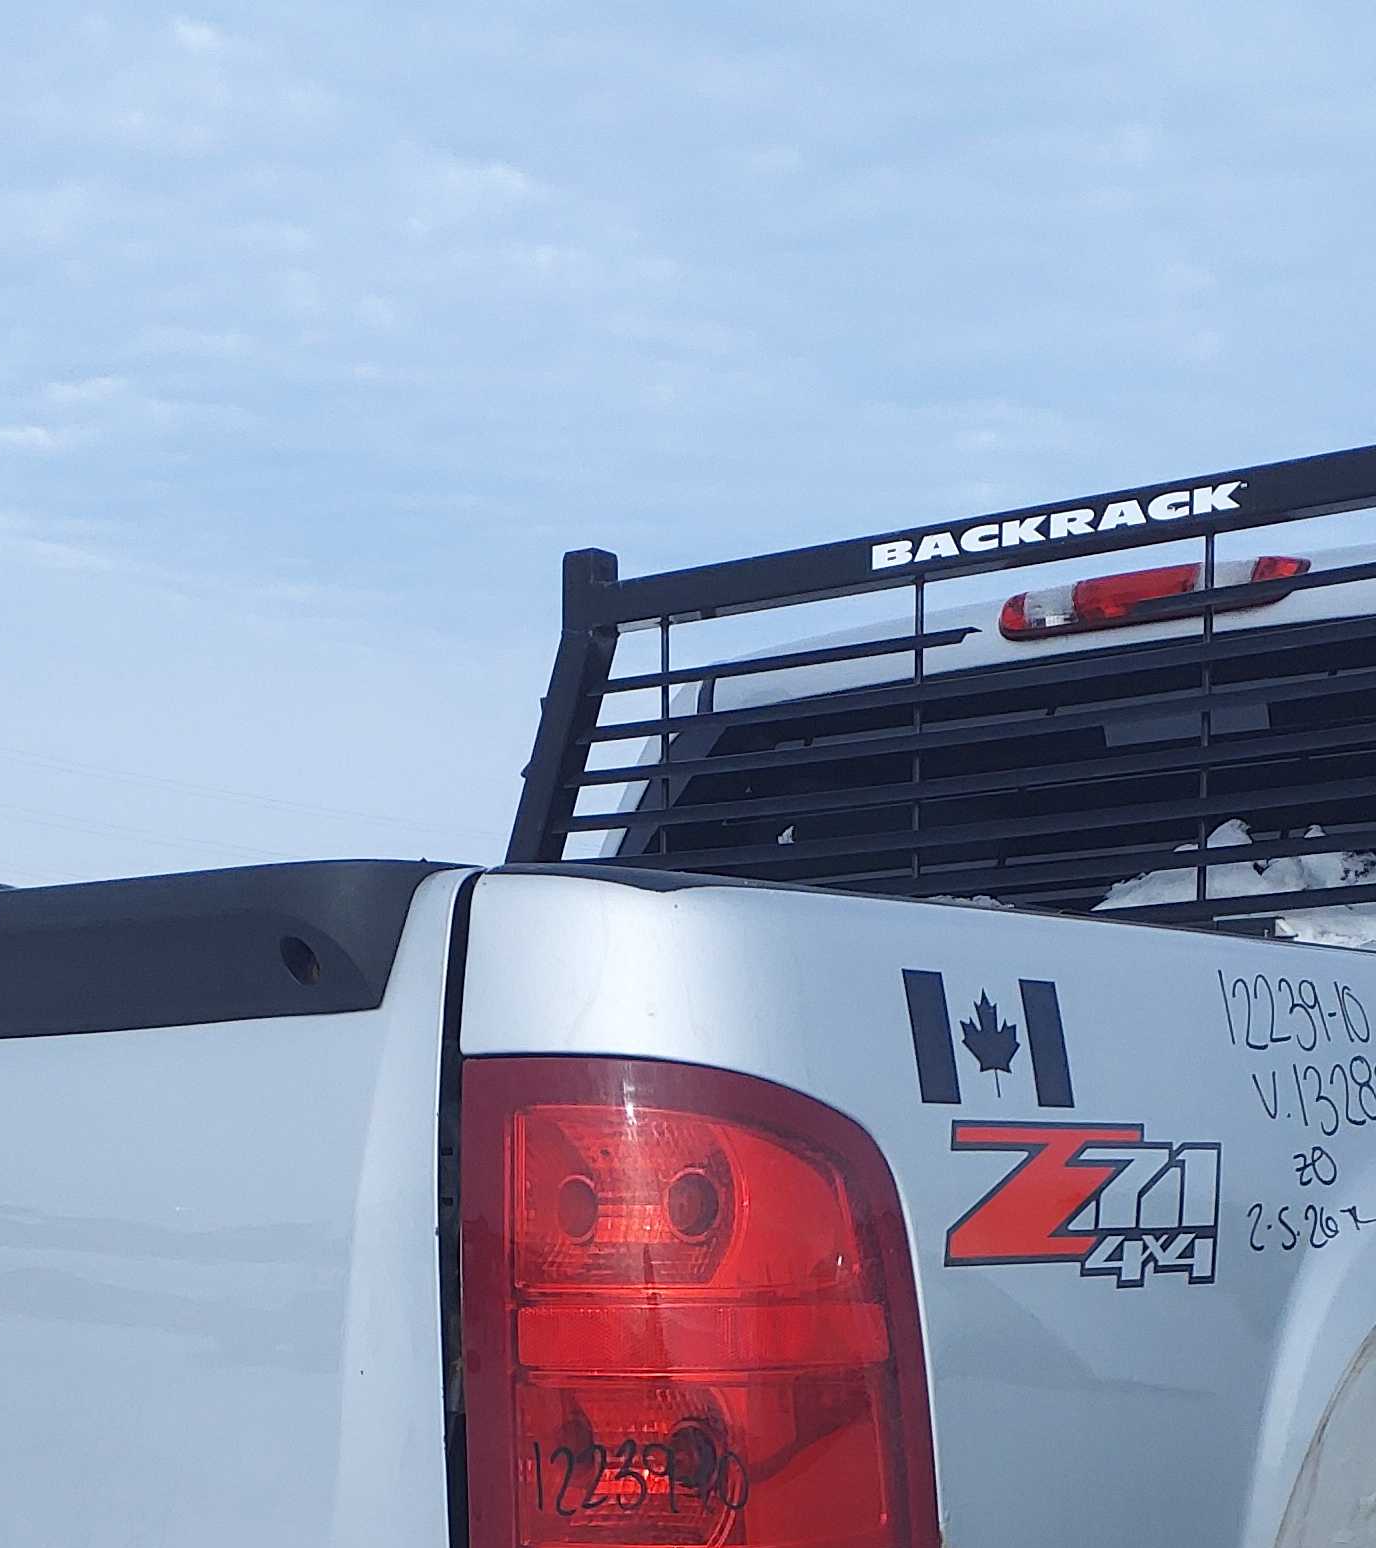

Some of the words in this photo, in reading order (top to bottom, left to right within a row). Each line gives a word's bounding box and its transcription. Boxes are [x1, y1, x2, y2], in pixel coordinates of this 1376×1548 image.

[871, 481, 1241, 571] BACKRACK
[1218, 969, 1370, 1051] 12239-10
[944, 1120, 1222, 1267] Z71
